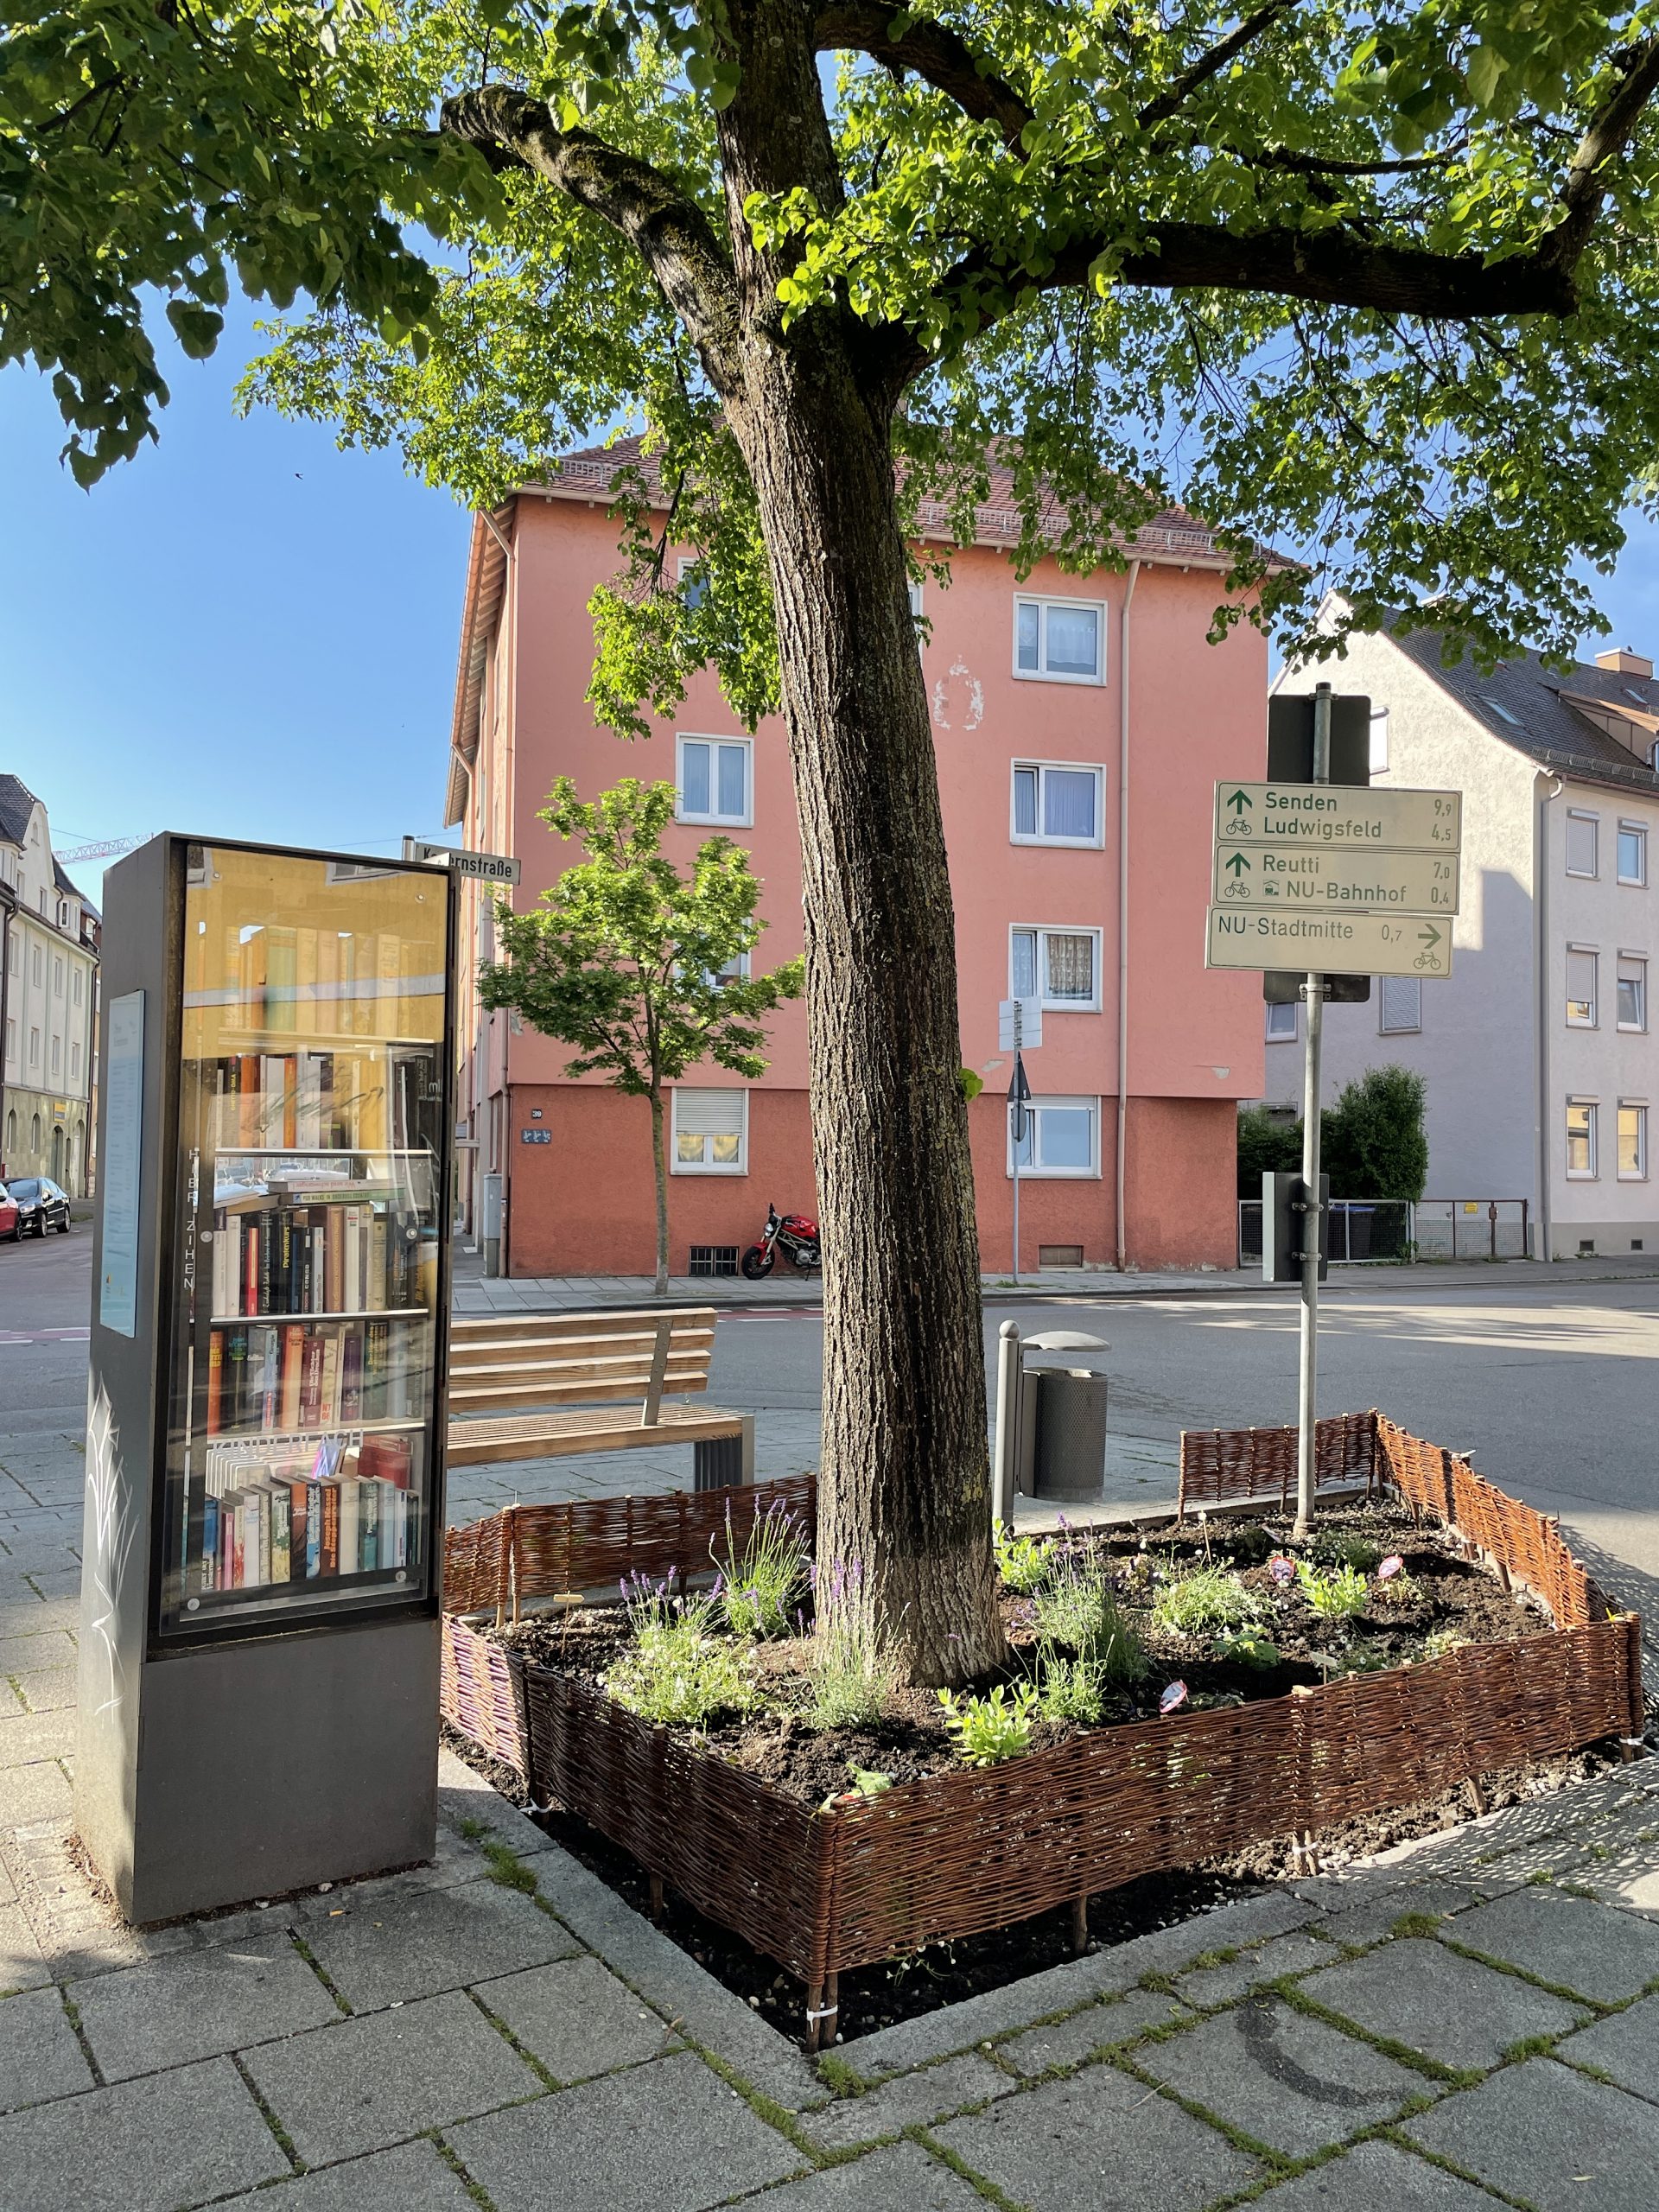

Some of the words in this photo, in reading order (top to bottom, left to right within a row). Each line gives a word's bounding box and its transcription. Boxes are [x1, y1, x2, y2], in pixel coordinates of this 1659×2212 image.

[1264, 791, 1338, 811] Senden
[1433, 798, 1452, 817] 9,9
[1263, 817, 1382, 840] Ludwigsfeld
[1431, 823, 1452, 842] 4,5
[1262, 855, 1320, 874] Reutti
[1433, 862, 1450, 880] 7,0
[1287, 880, 1408, 903] NU-Bahnhof
[1430, 887, 1449, 905] 0,4
[1218, 916, 1354, 940] NU-Stadtmitte
[1381, 925, 1402, 944] 0,7
[212, 1429, 364, 1454] KINDERFACH
[323, 1519, 332, 1550] Joseph
